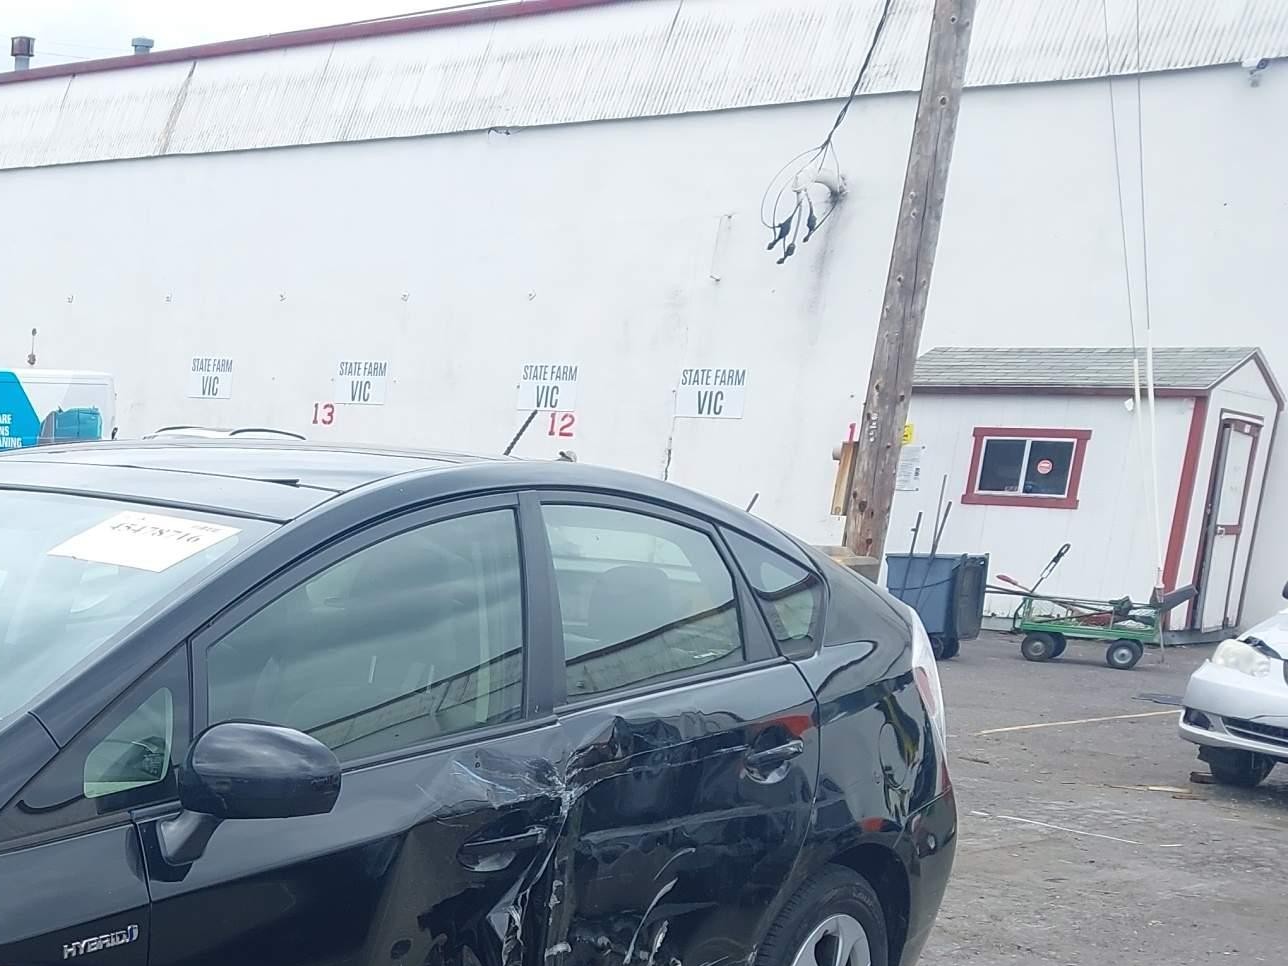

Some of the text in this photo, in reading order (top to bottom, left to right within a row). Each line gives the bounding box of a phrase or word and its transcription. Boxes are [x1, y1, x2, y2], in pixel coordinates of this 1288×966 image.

[191, 358, 233, 373] STATE FARM
[339, 361, 387, 377] STATE FARM
[522, 364, 578, 382] STATE FARM
[201, 375, 219, 396] VIC
[681, 368, 746, 386] STATE FARM
[350, 380, 371, 402] VIC
[535, 385, 559, 409] VIC
[312, 403, 335, 425] 13
[697, 390, 724, 416] VIC
[548, 412, 575, 437] 12
[63, 925, 139, 959] HYBRID
